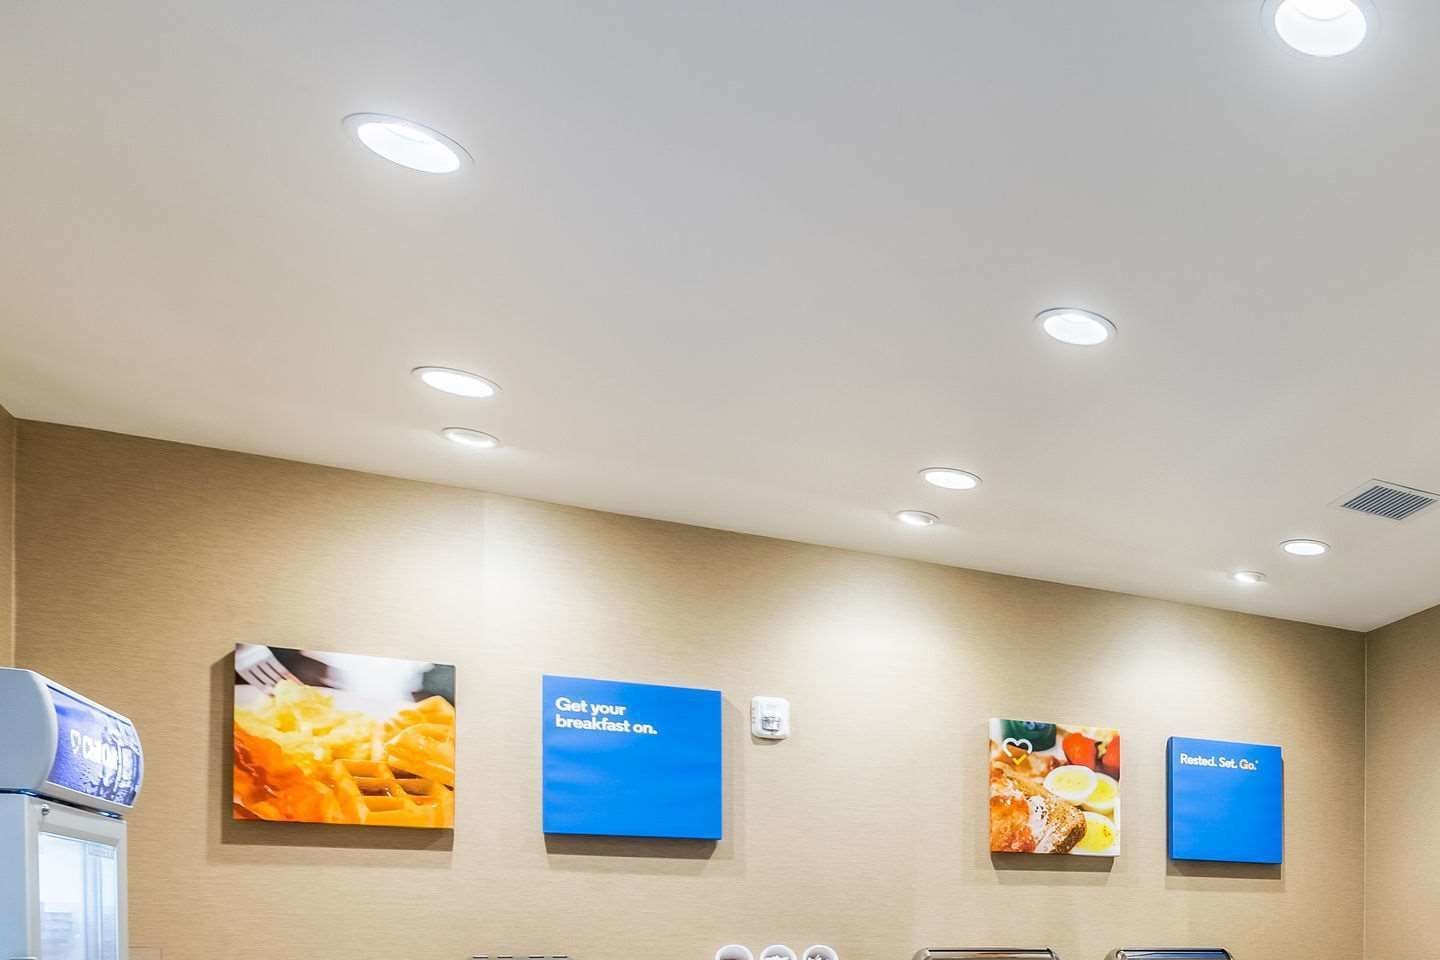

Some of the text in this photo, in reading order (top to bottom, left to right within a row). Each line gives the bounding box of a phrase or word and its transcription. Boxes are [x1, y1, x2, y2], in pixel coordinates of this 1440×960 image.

[555, 696, 627, 716] Get your
[555, 713, 658, 735] breakfast on.
[1180, 752, 1218, 767] Rested.
[1218, 756, 1238, 769] Set.
